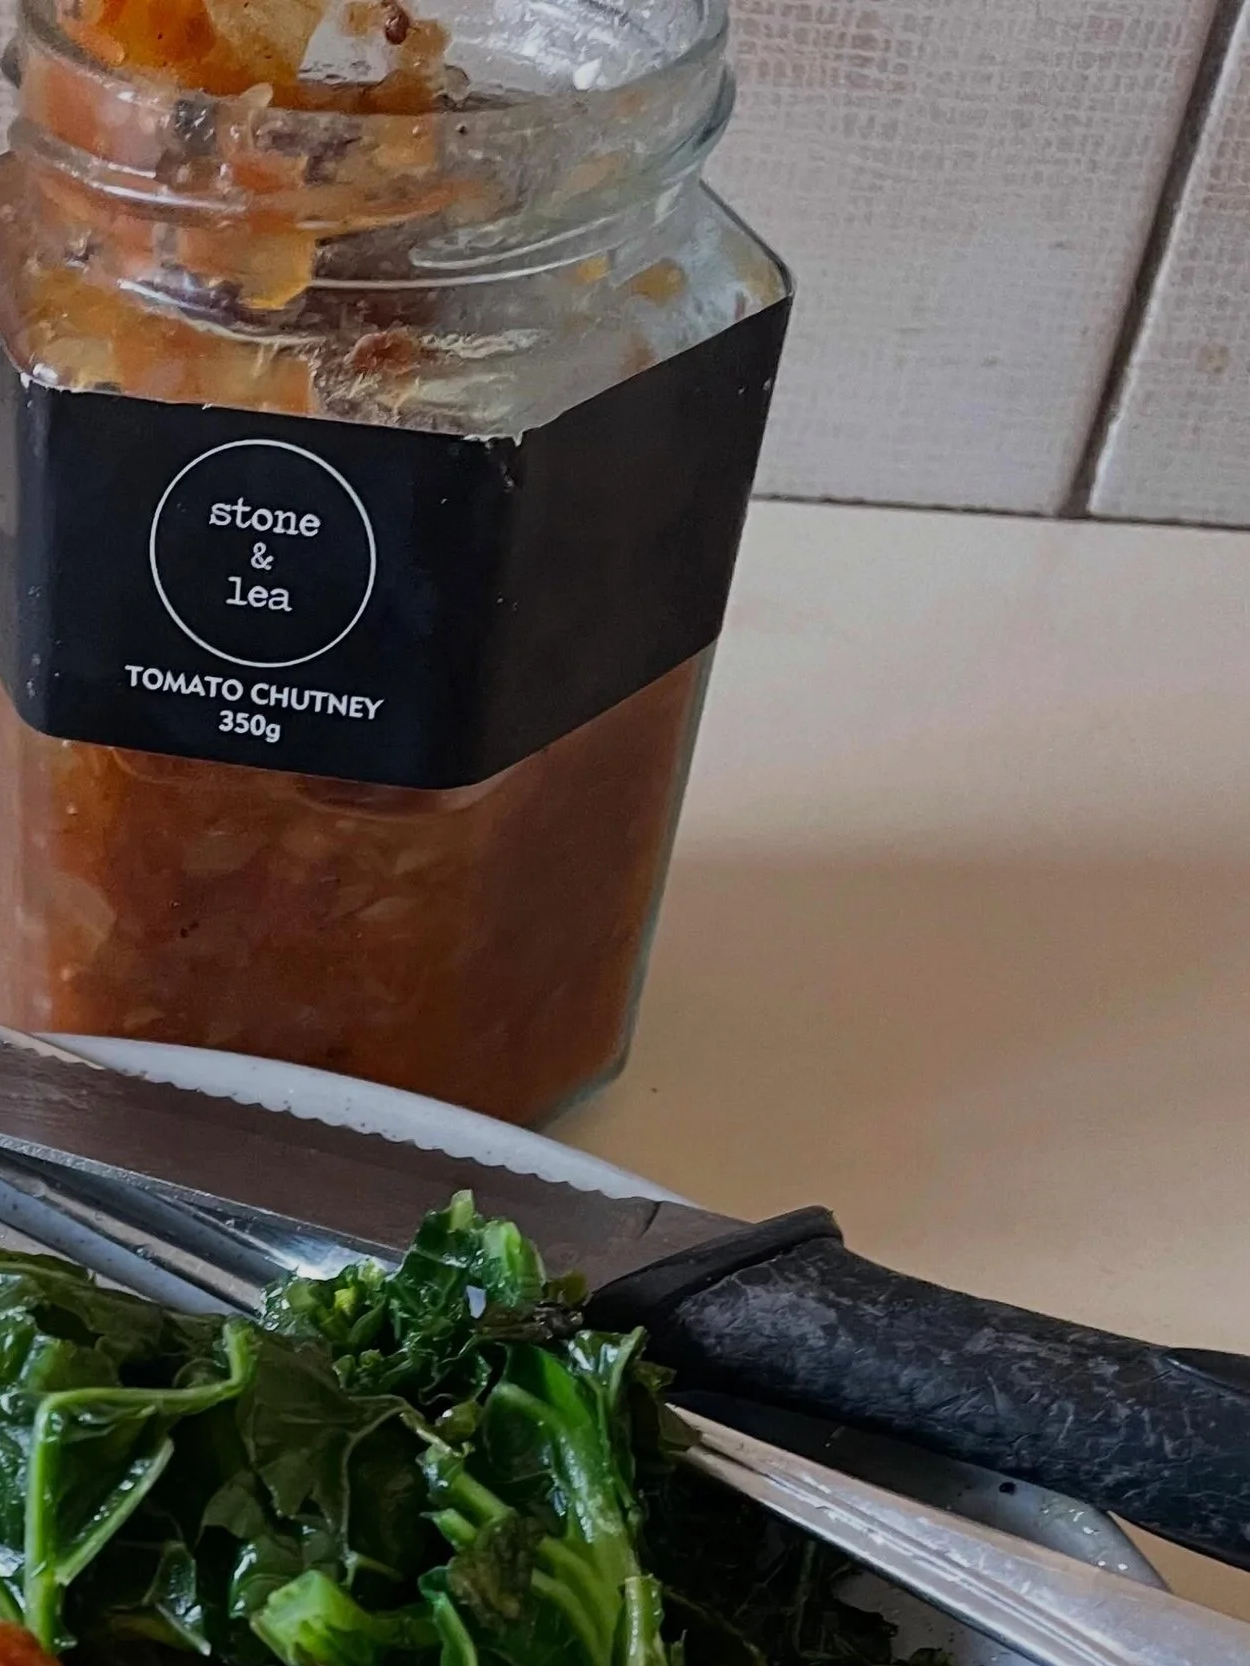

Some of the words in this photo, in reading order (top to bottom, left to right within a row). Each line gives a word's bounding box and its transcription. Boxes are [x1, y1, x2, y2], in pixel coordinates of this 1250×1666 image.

[208, 497, 322, 538] stone
[250, 542, 274, 571] &
[226, 576, 293, 613] lea
[124, 664, 244, 702] TOMATO
[250, 681, 385, 721] CHUTNEY
[218, 710, 282, 743] 350g
